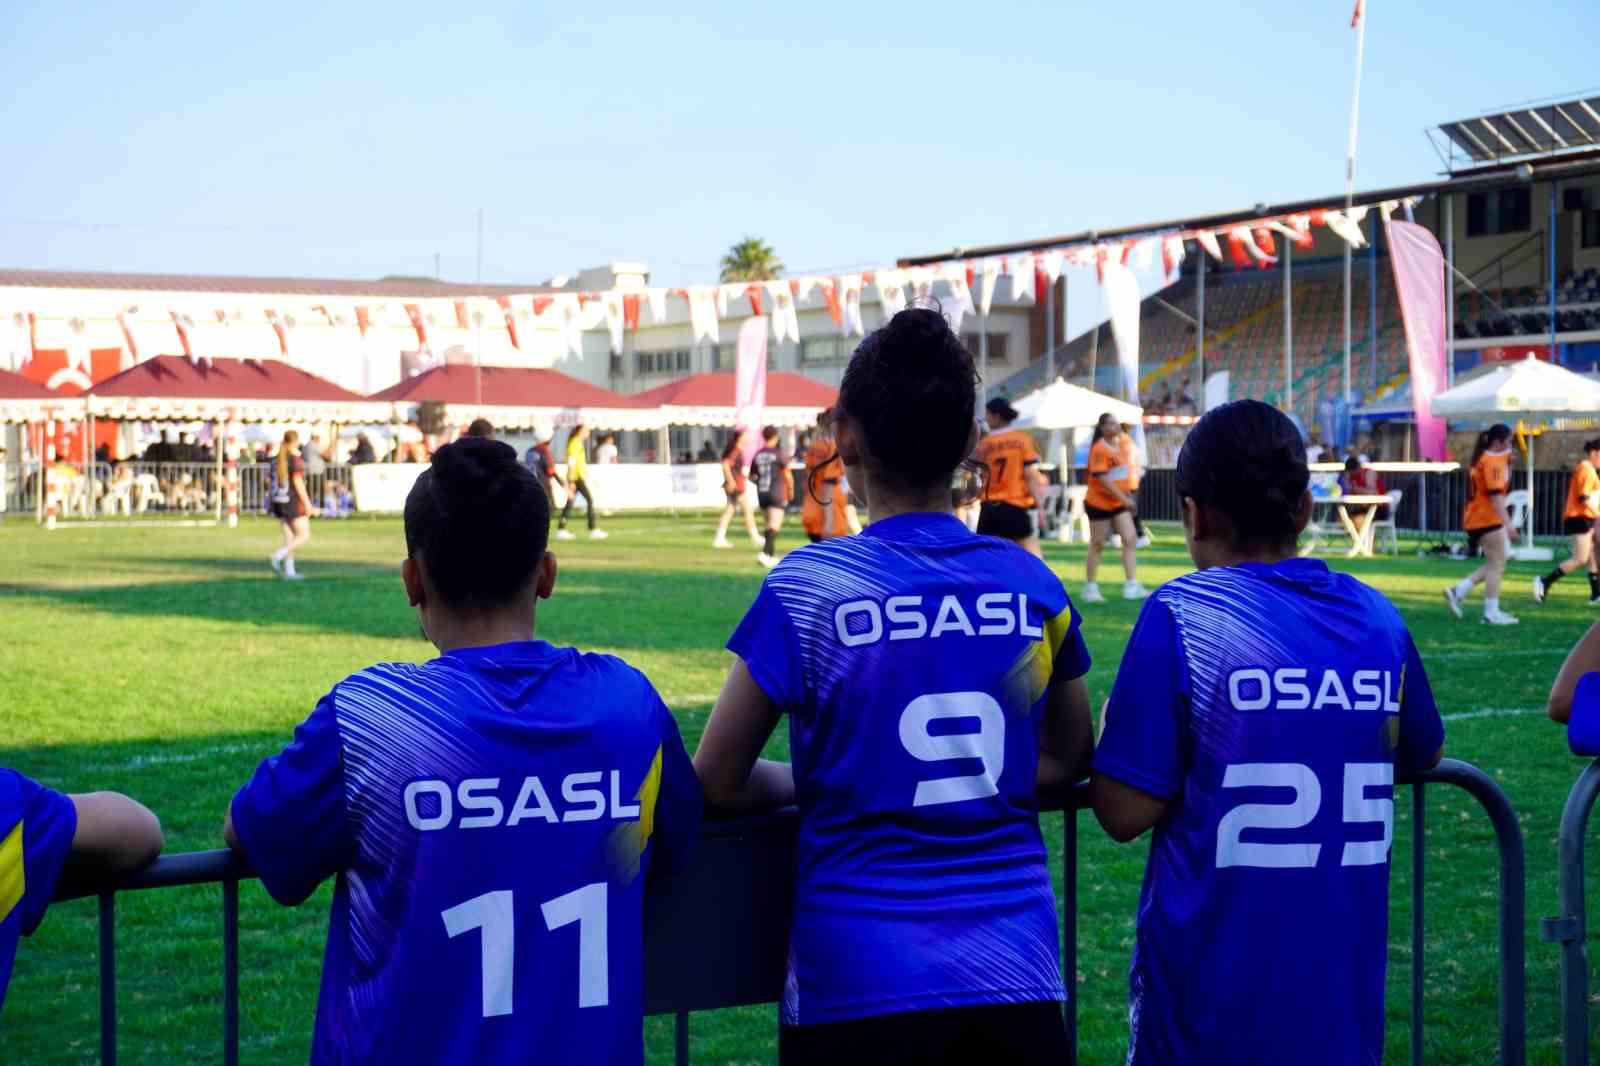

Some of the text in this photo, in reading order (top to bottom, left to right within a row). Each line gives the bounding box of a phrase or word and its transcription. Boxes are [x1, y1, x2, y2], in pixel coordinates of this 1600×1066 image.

[995, 457, 1008, 482] 7
[834, 591, 1044, 647] OSASL
[1229, 668, 1400, 713] OSASL
[899, 691, 1005, 807] 9
[403, 770, 641, 832] OSASL
[1215, 763, 1394, 868] 25
[441, 882, 609, 1018] 11
